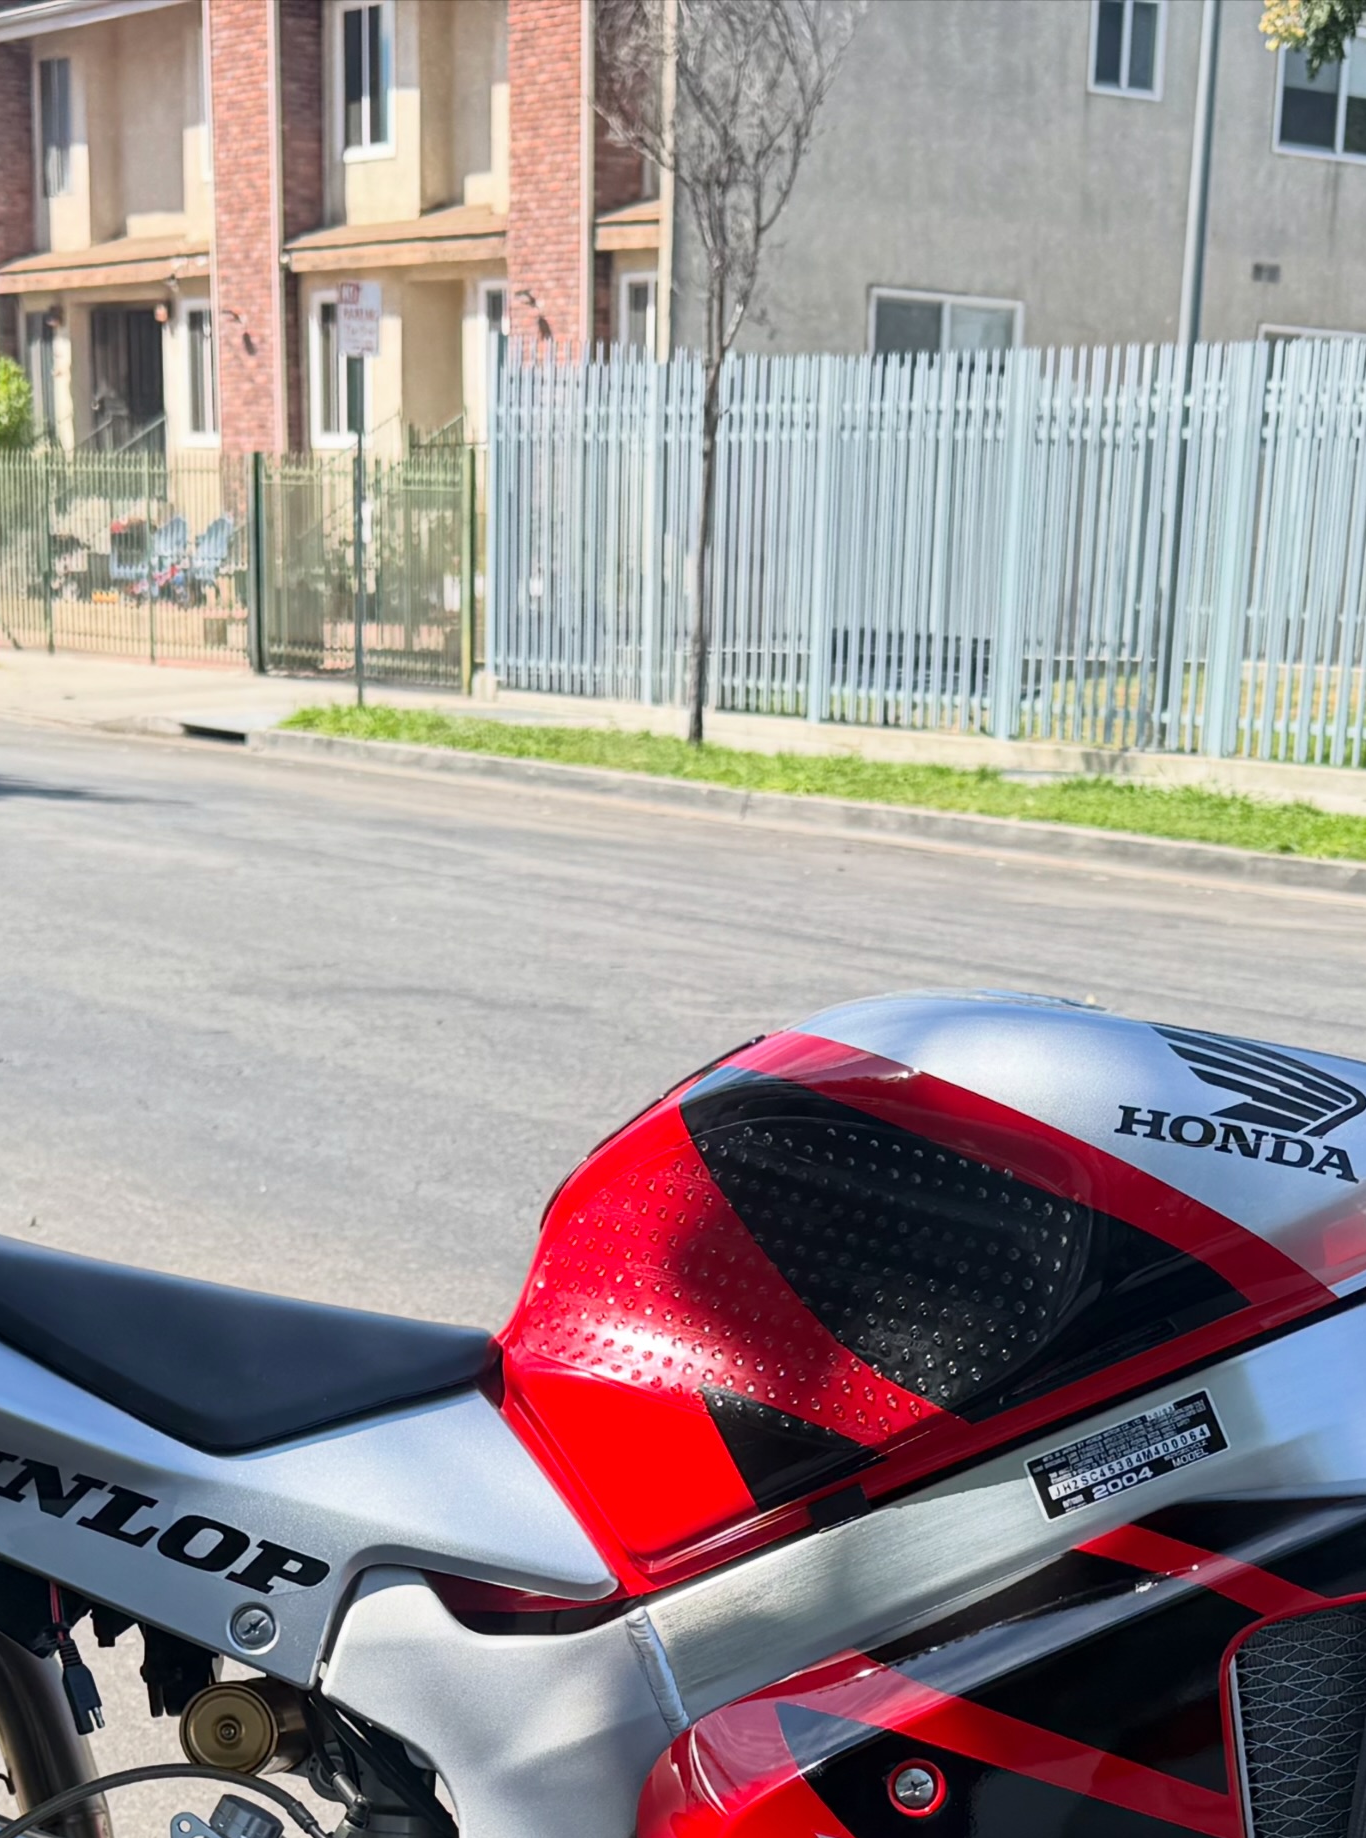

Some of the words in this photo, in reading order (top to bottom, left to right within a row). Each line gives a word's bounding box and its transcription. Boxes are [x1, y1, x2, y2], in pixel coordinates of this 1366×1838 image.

[1114, 1104, 1360, 1184] HONDA
[1092, 1466, 1154, 1500] 2004
[1172, 1448, 1210, 1468] MODEL
